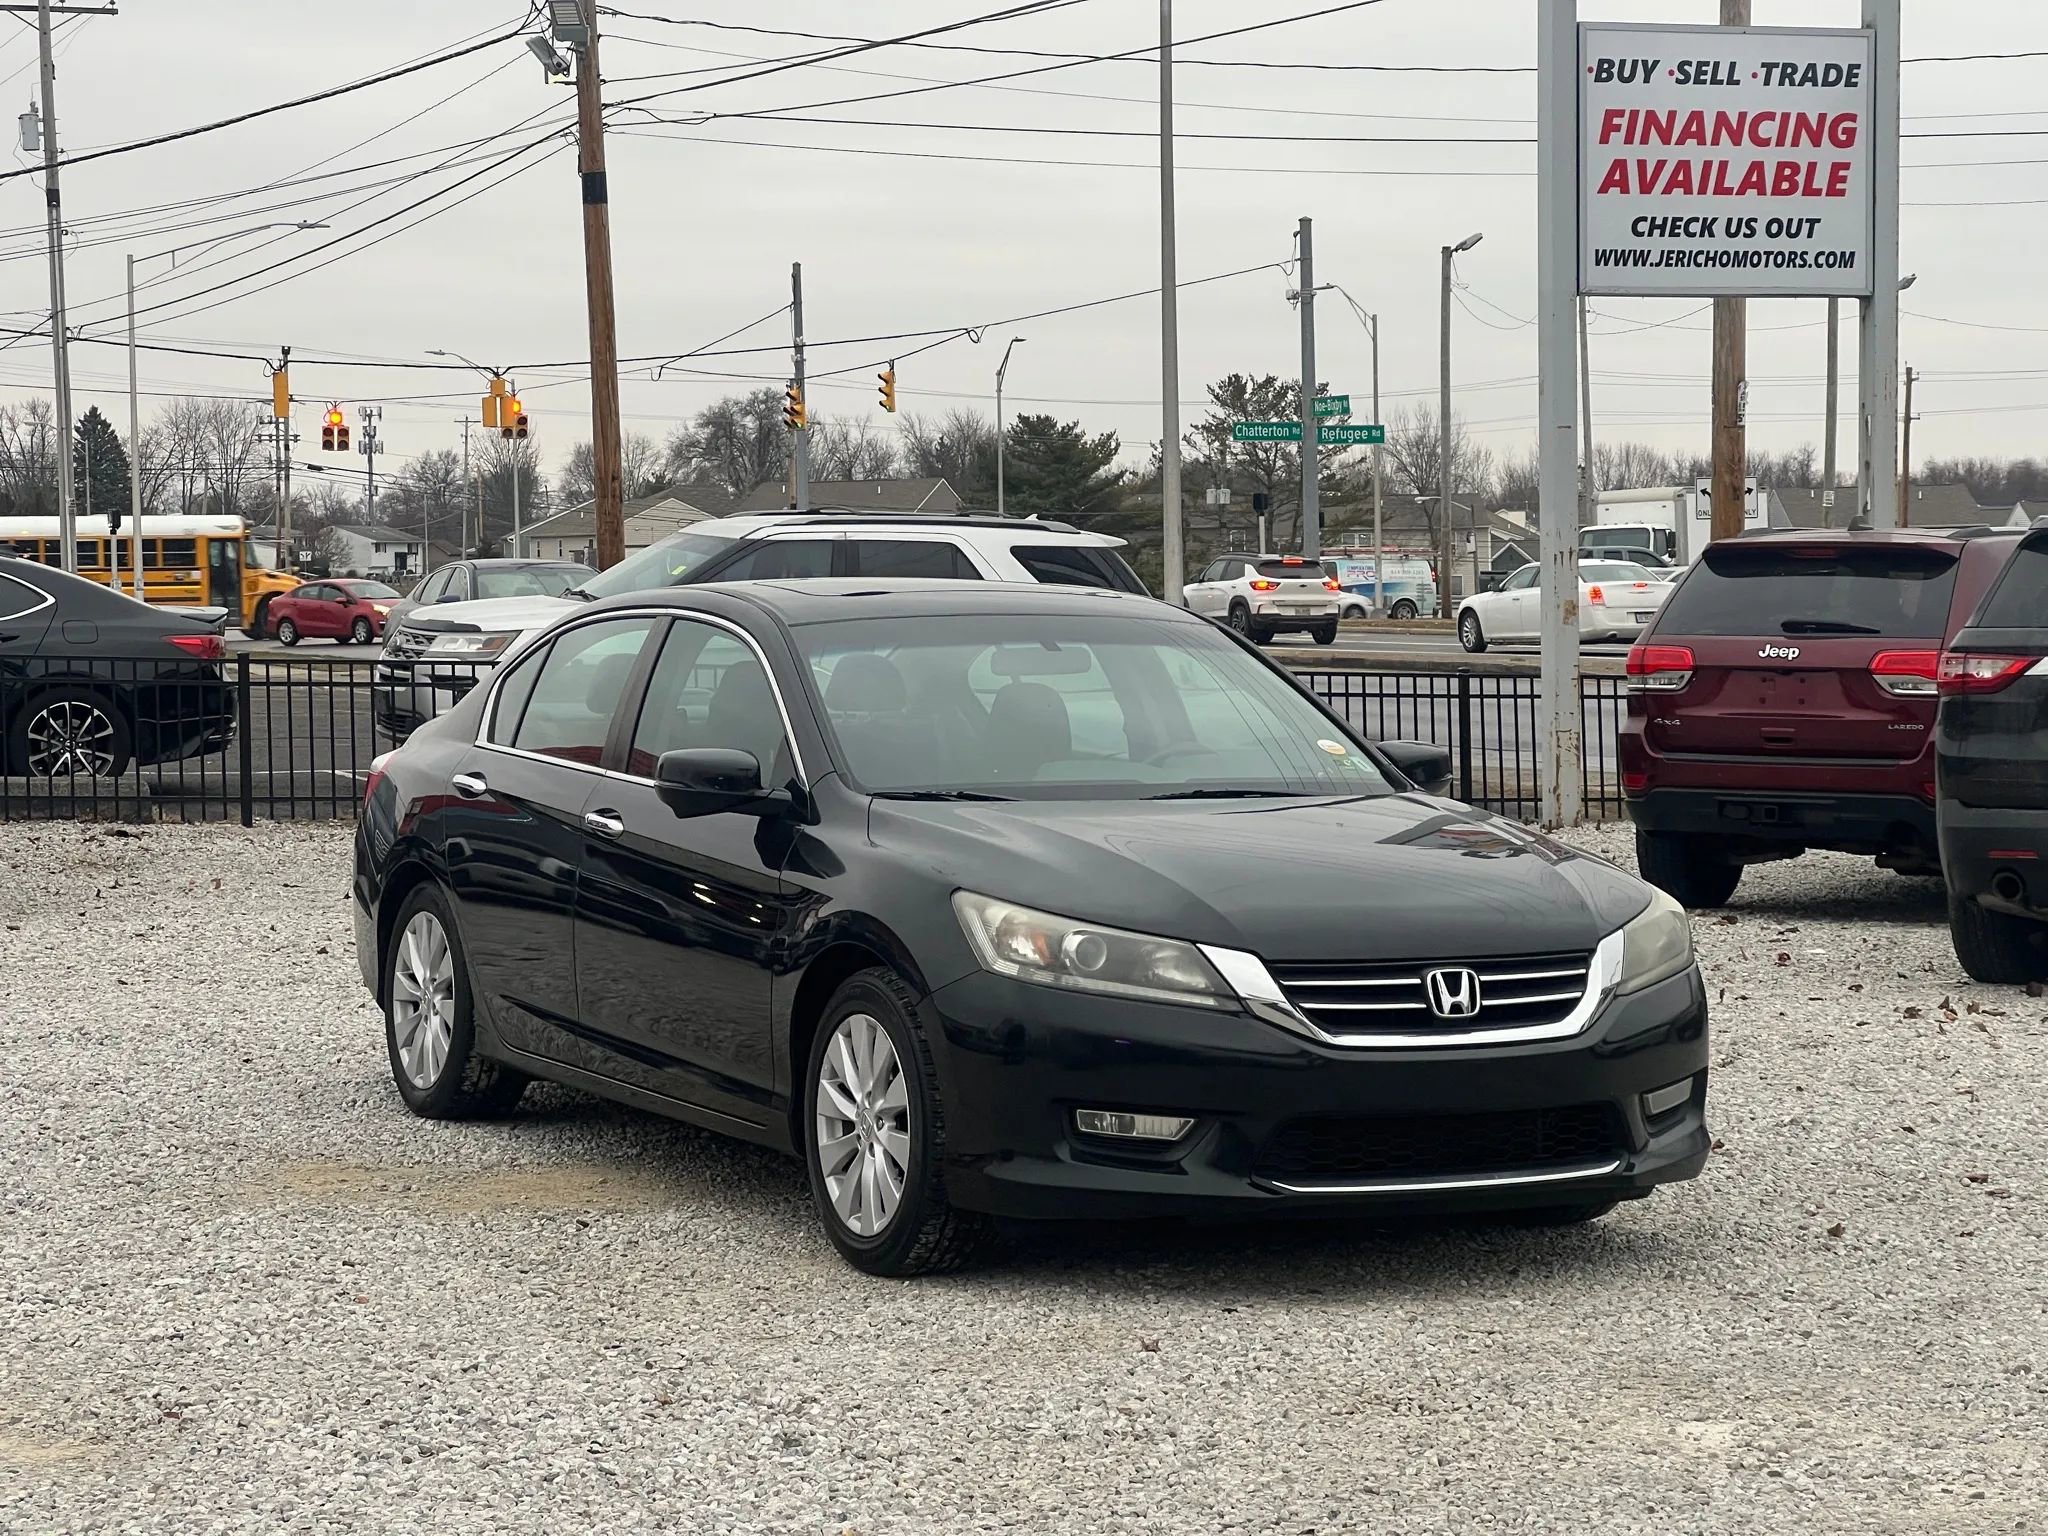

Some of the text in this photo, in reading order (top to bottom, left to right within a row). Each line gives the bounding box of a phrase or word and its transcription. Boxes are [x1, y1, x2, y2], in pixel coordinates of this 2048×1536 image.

[1599, 109, 1858, 149] FINANCING
[1597, 158, 1851, 197] AVAILABLE
[1631, 216, 1822, 239] CHECK US OUT
[1594, 248, 1856, 269] WWW.JERICHOMOTORS.COM
[1314, 399, 1343, 413] Noe-Bixby
[1235, 424, 1301, 437] Chatterton Rd
[1321, 427, 1381, 443] Refugee Rd
[1697, 509, 1711, 517] ONL
[1758, 643, 1800, 661] Jeep
